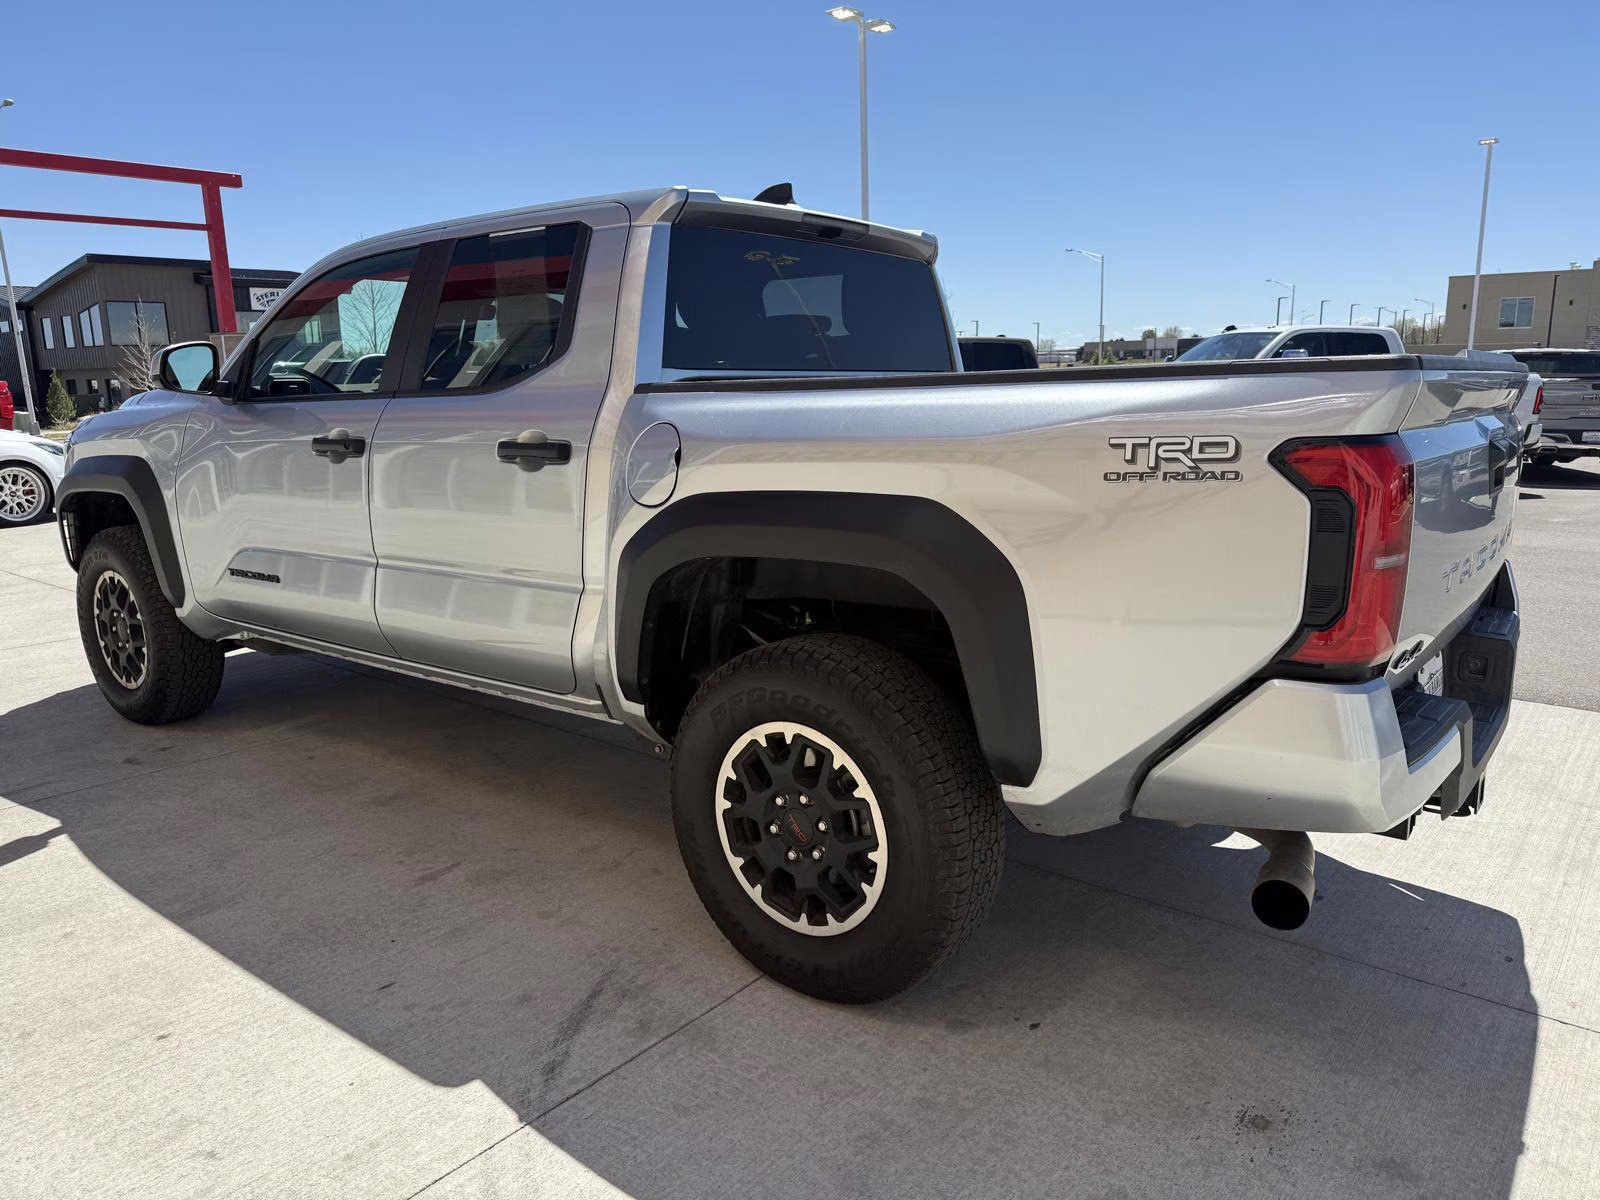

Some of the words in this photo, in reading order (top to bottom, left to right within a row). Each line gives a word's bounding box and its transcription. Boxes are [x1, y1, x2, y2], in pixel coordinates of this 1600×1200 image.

[255, 291, 280, 302] STERI
[1108, 435, 1240, 470] TRD
[1103, 471, 1159, 483] OFF
[1162, 471, 1243, 483] ROAD
[1441, 519, 1515, 594] TACOMA
[228, 568, 281, 583] TACOMA
[787, 814, 807, 842] TRD
